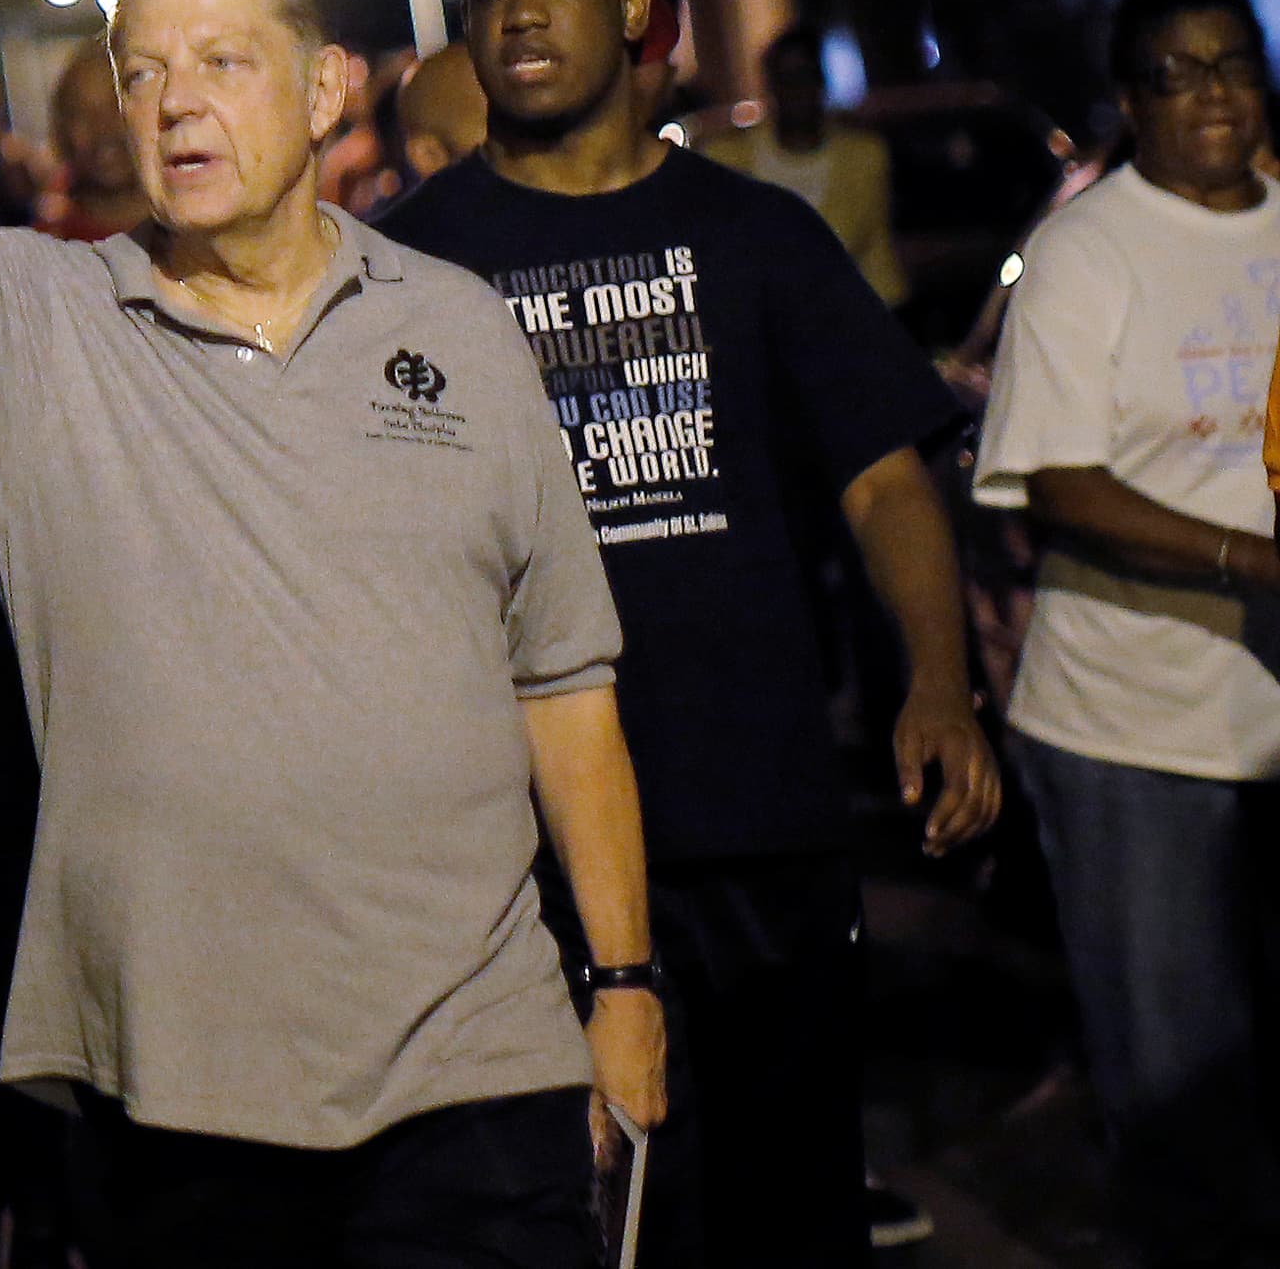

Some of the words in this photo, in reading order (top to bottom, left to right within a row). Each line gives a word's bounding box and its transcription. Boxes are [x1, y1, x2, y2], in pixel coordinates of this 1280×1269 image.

[665, 245, 695, 276] IS
[583, 273, 699, 327] MOST
[531, 314, 713, 368] OWERFUL
[623, 352, 710, 388] WHICH
[655, 380, 713, 415] USE
[583, 408, 715, 460] CHANGE
